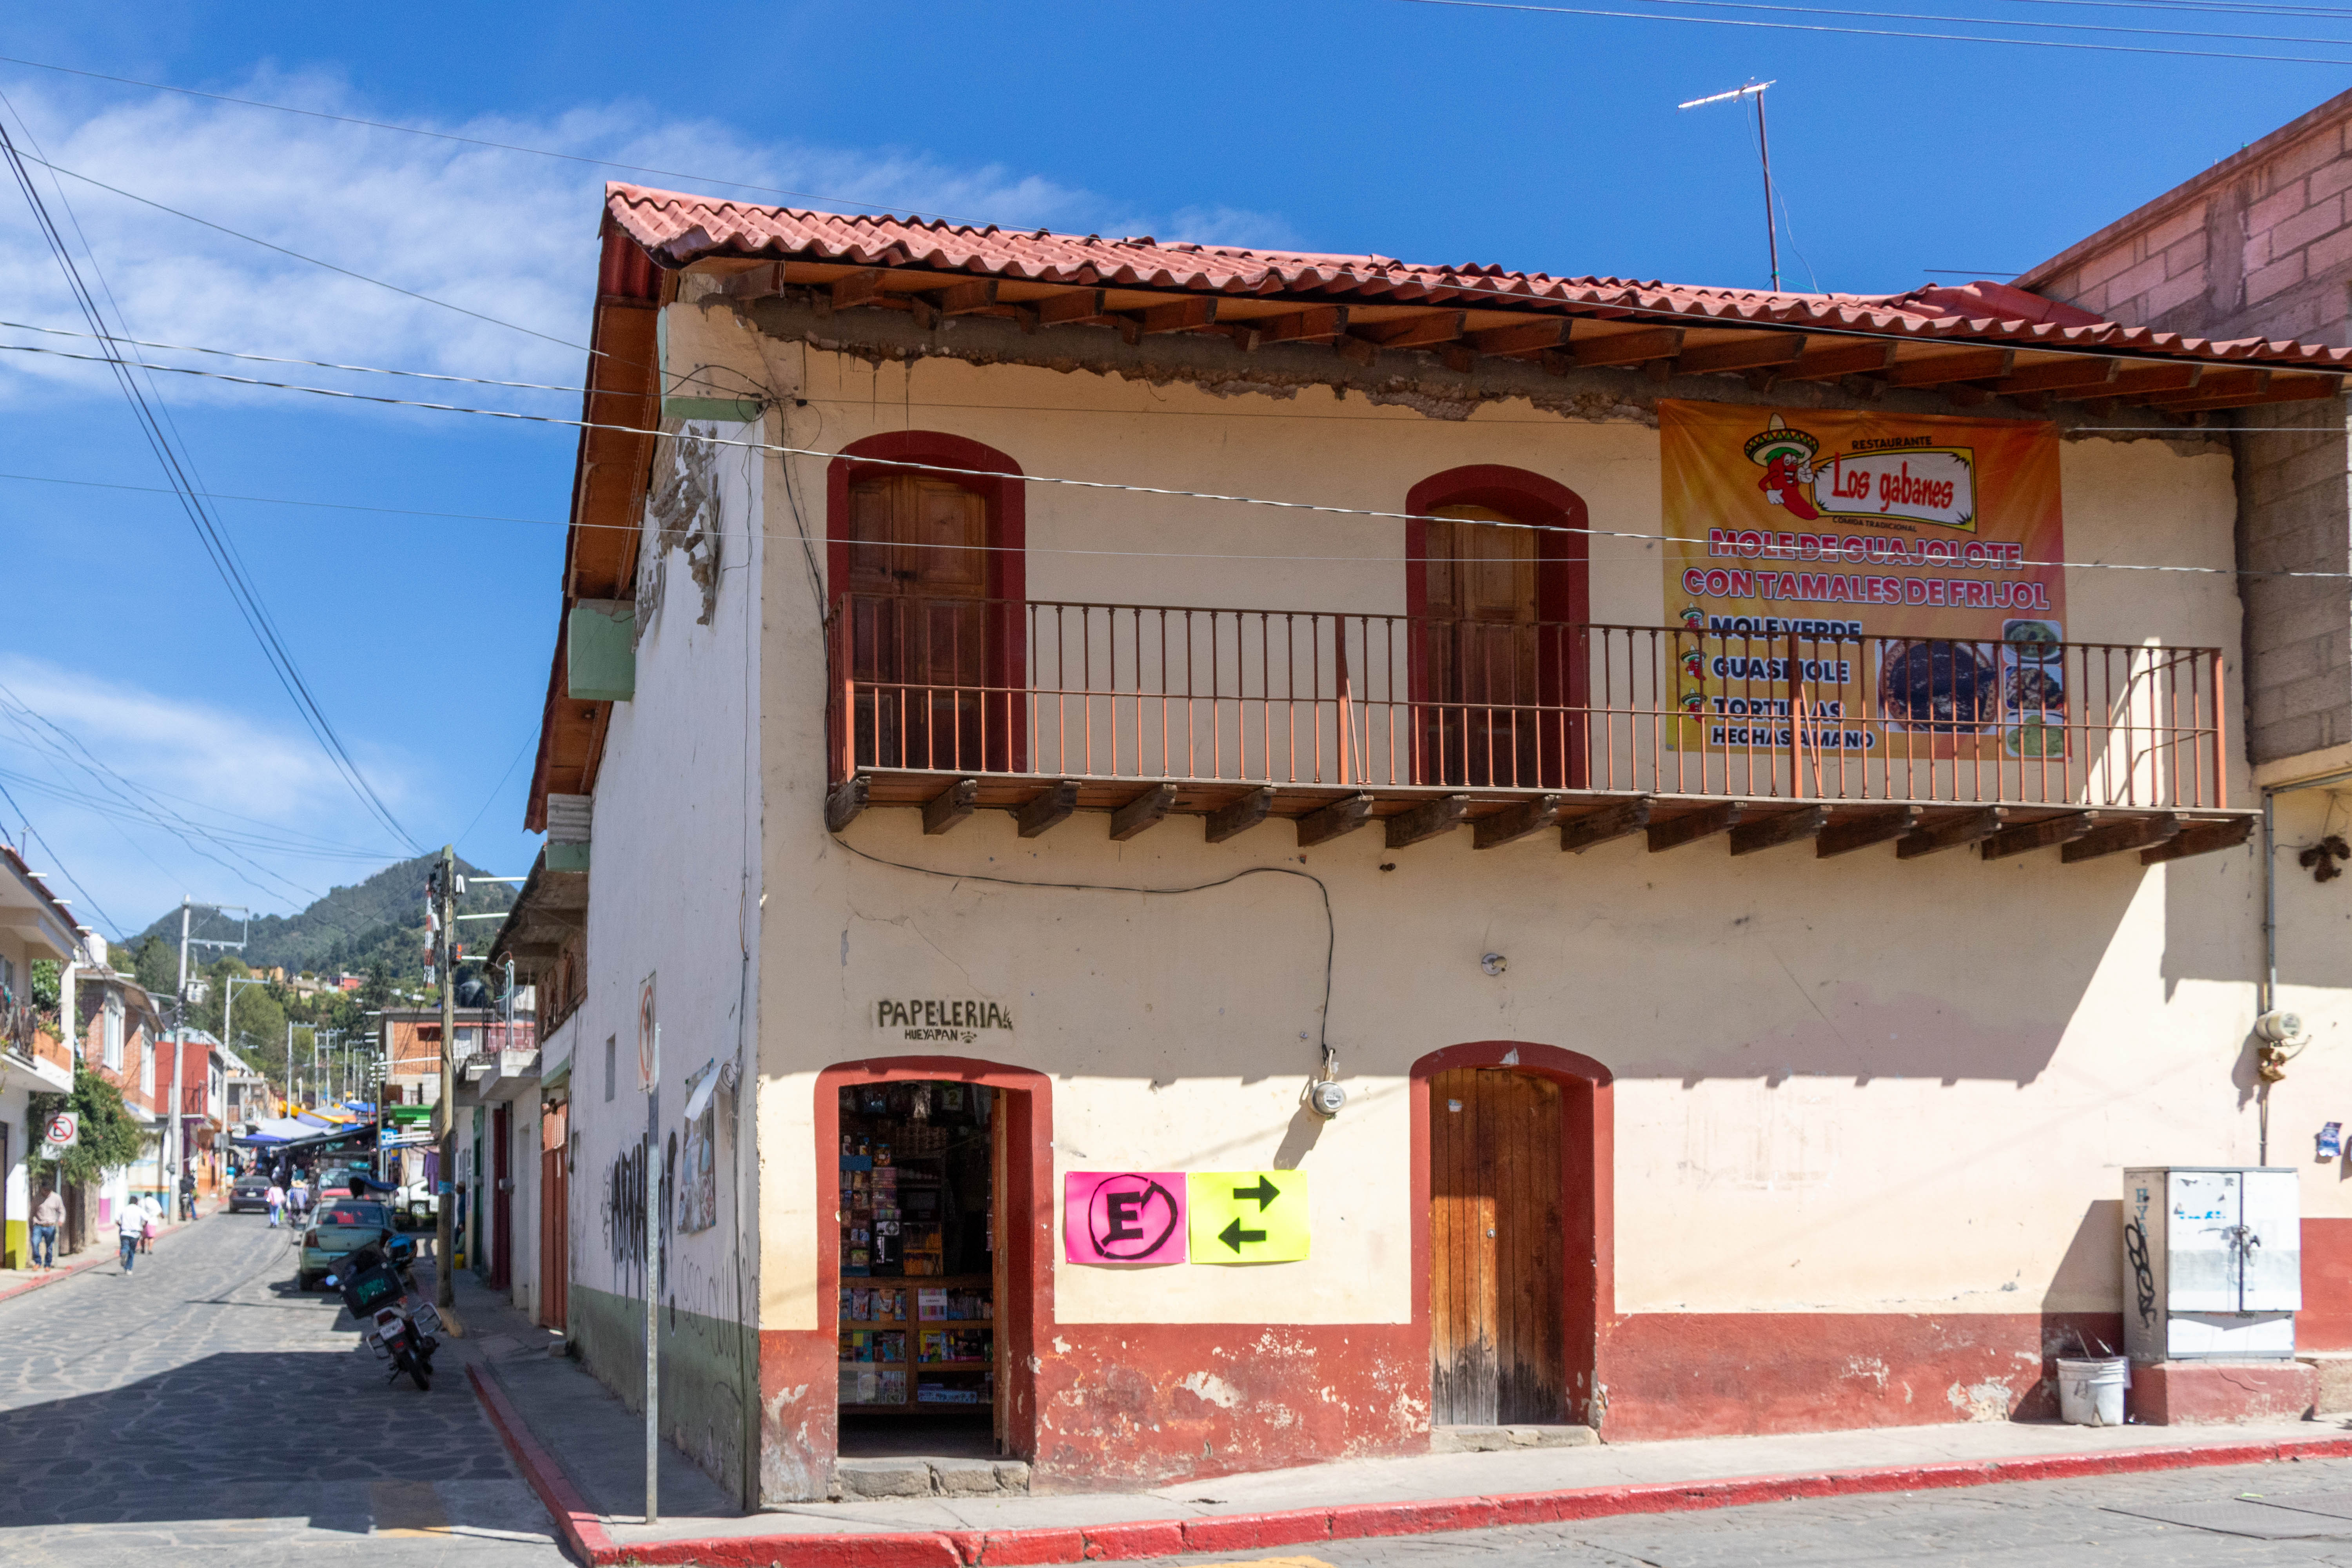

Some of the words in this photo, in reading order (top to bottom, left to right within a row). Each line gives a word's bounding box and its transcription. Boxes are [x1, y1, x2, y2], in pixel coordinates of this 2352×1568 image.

[1852, 436, 1932, 450] RESTAURANTE
[1832, 452, 1870, 499] Los
[1880, 461, 1954, 512] gabanes
[1833, 517, 1863, 526] COMIDA
[1866, 521, 1917, 532] TRADICIONAL
[1709, 528, 1796, 560] MOLE
[1798, 533, 1840, 562] DE
[1842, 535, 2024, 570] GUAJOLOTE
[1682, 568, 1755, 598] CON
[1756, 571, 1902, 605] TAMALES
[1904, 577, 1945, 606] DE
[1948, 579, 2051, 610] FRIJOL
[1709, 614, 1780, 641] MOLE
[1780, 618, 1862, 644] VERDE
[1711, 696, 1846, 724] TORTILAS
[1710, 726, 1794, 747] HECHAS
[1812, 729, 1875, 750] MANO
[878, 1000, 1003, 1029] PAPELERIA
[904, 1029, 958, 1041] HUEYAPAN
[1106, 1191, 1143, 1242] E
